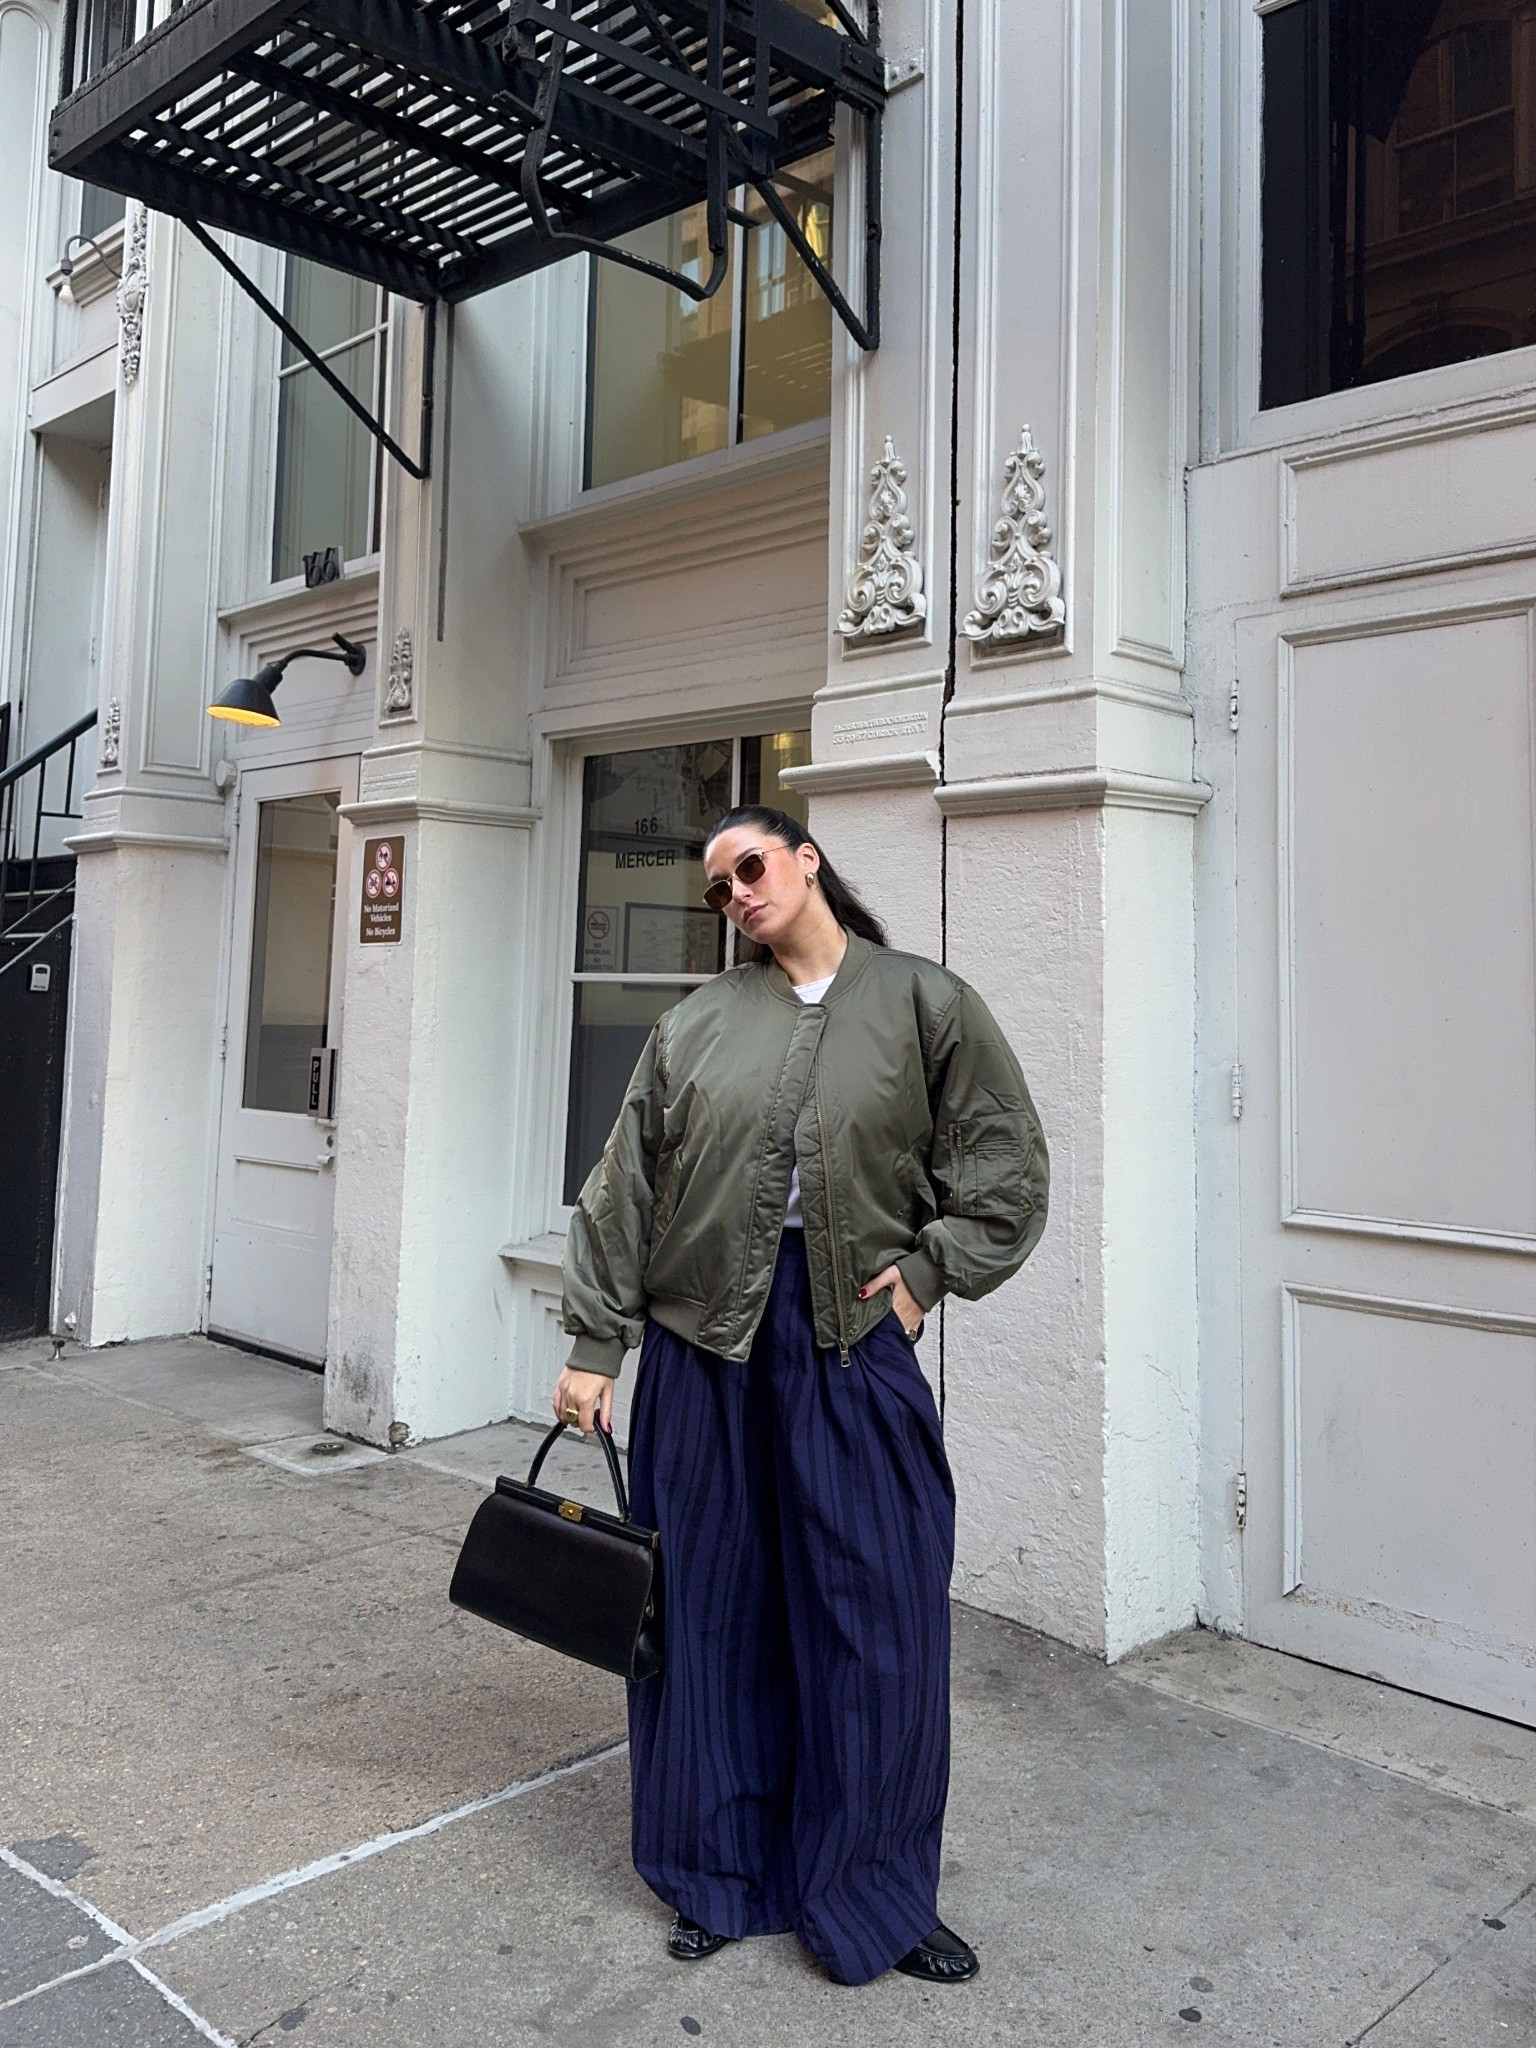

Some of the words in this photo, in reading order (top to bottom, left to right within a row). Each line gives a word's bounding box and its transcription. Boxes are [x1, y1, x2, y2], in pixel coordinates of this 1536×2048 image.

[635, 816, 658, 836] 166
[615, 849, 675, 869] MERCER
[364, 904, 372, 913] No
[372, 902, 399, 913] Motorized
[370, 913, 392, 923] Vehicles
[366, 927, 373, 936] No
[374, 926, 396, 938] Bicycles
[311, 1060, 319, 1105] PULL
